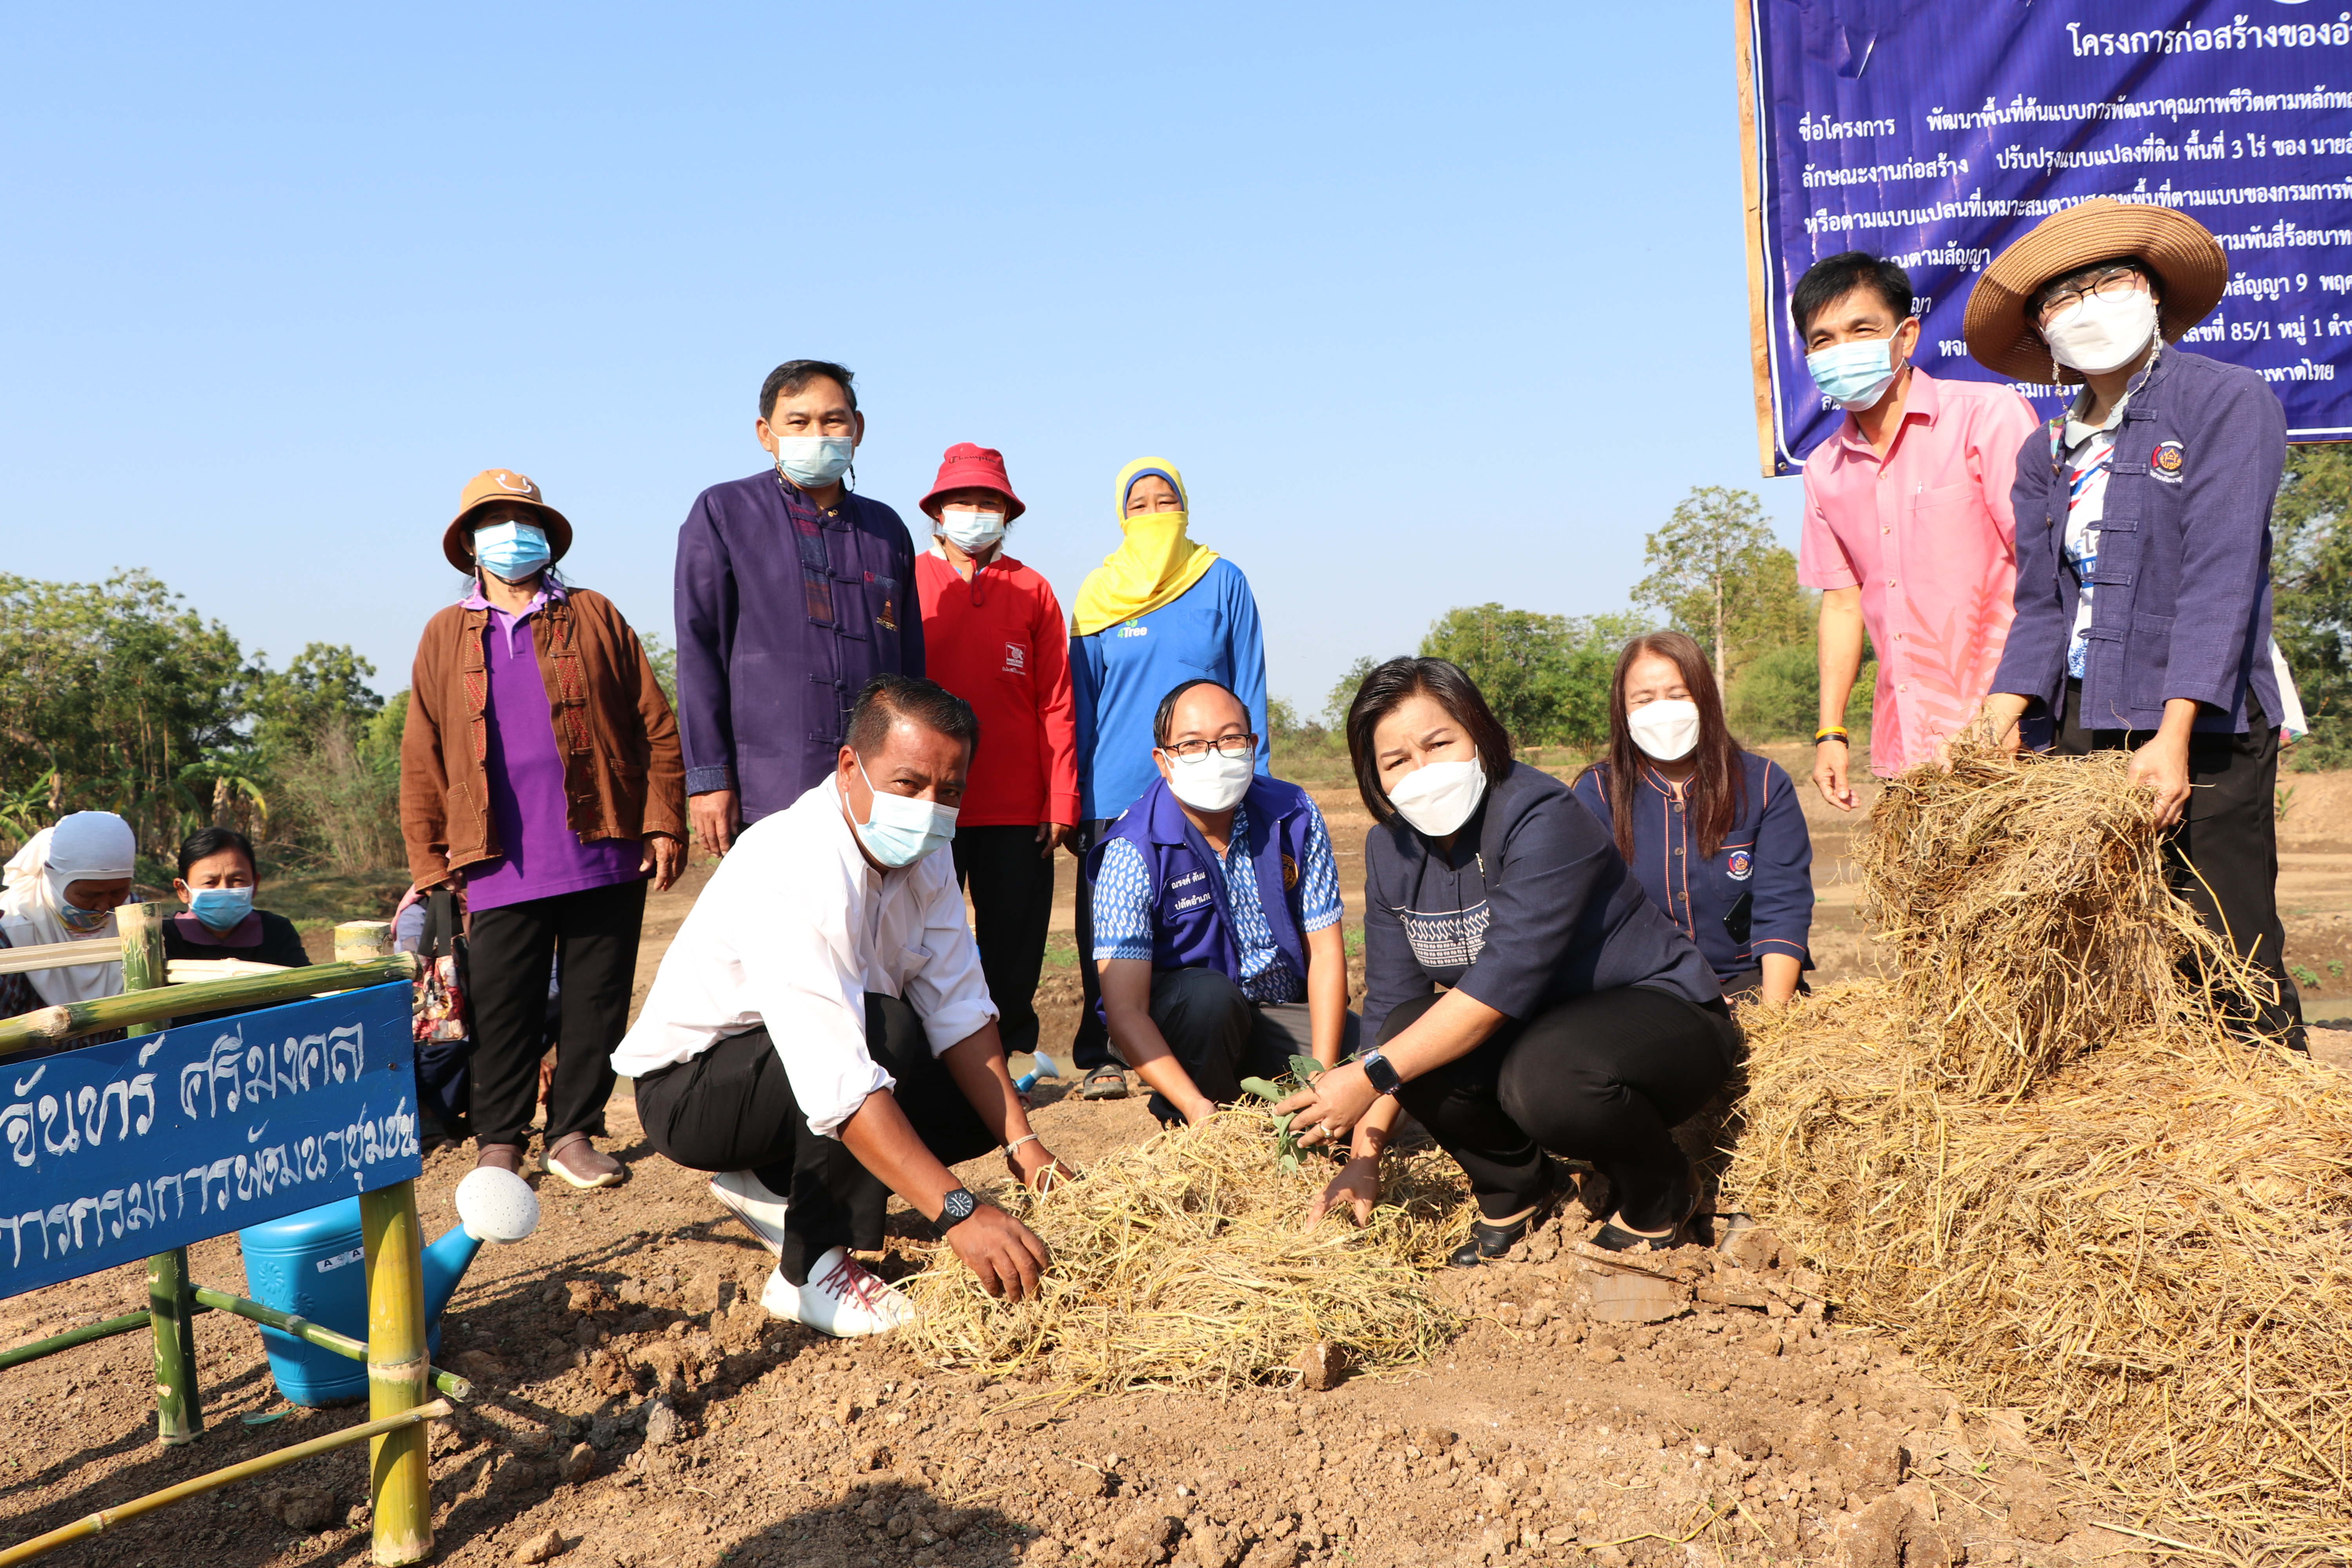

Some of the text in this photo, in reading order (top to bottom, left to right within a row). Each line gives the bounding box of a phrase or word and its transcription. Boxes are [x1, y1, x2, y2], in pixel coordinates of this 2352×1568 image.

[1798, 111, 1895, 142] ชื่อโครงการ
[1802, 130, 2352, 187] ลักษณะงานก่อสร้าง ปรับปรุงแบบแปลงที่ดิน พื้นที่ 3 ไร่ ของ นายอ
[2213, 219, 2352, 250] สามพันสี่ร้อยบาท
[2296, 273, 2308, 292] 9
[2183, 313, 2225, 343] เลขที่
[2231, 321, 2271, 341] 85/1
[2278, 315, 2307, 345] หมู่
[2313, 319, 2323, 337] 1
[1117, 626, 1148, 638] 4Tree
[1171, 874, 1191, 889] ณรงค์
[180, 1022, 364, 1120] ศรีมงคล
[352, 1249, 361, 1258] A
